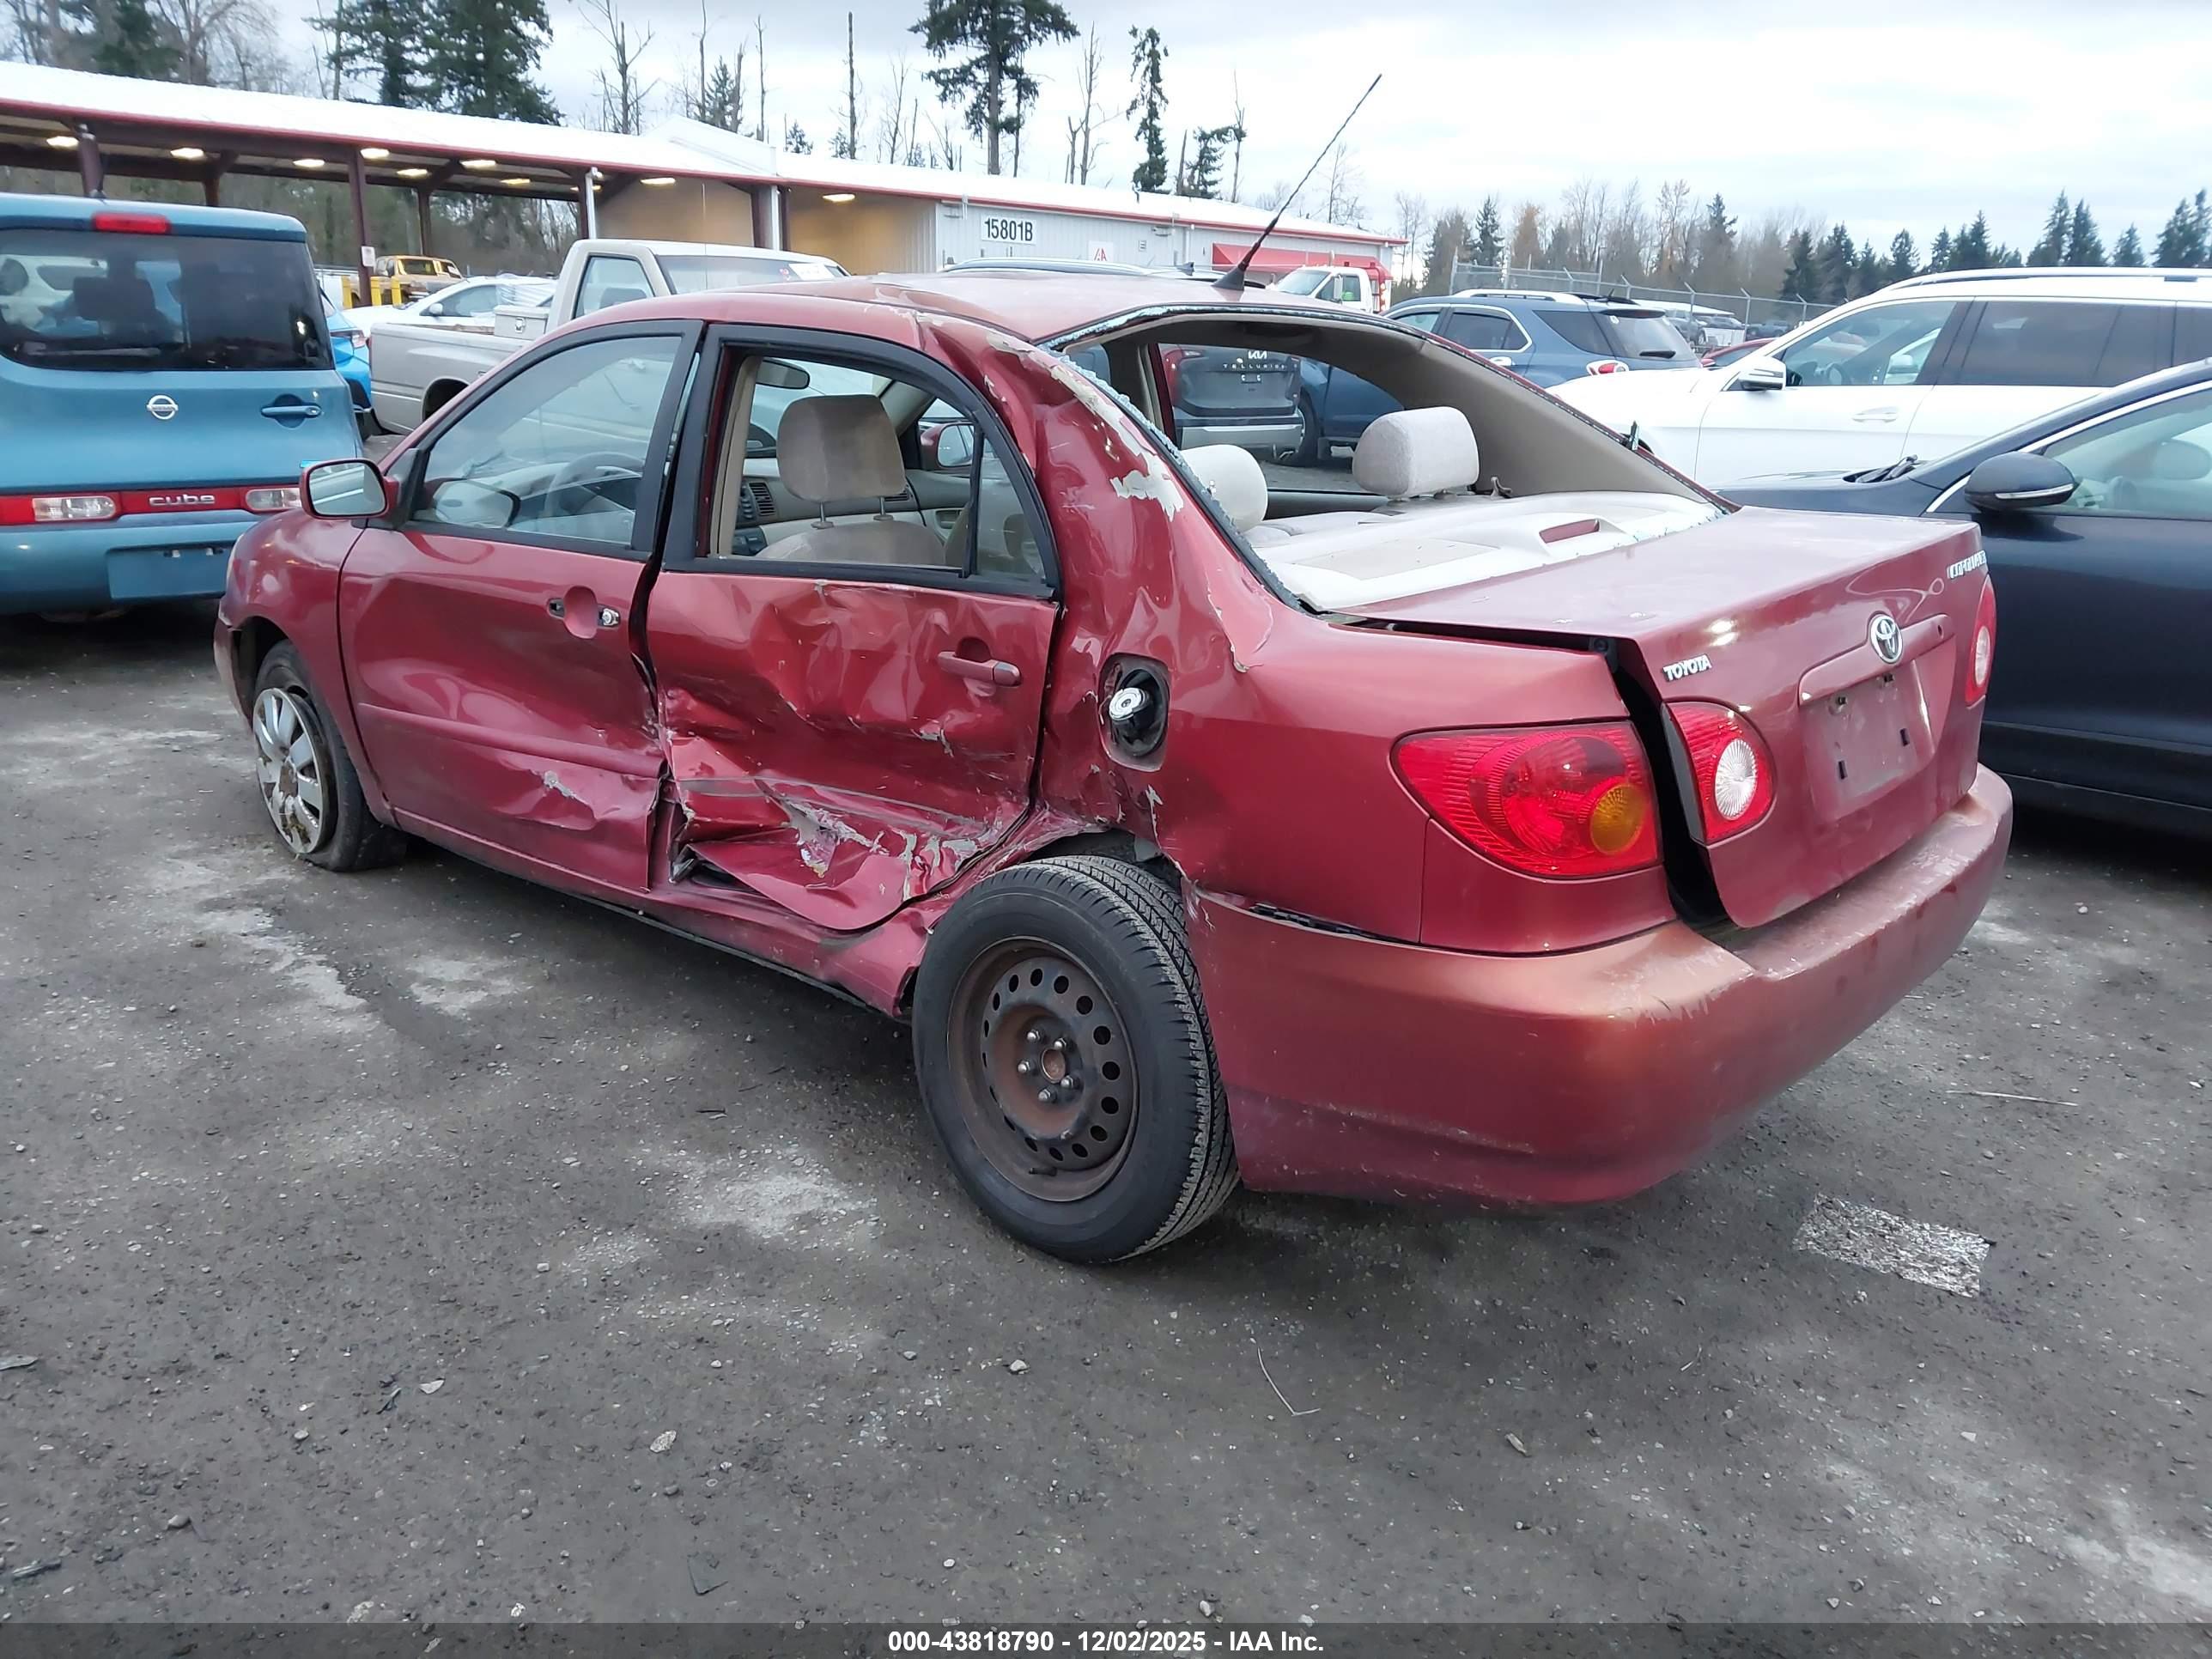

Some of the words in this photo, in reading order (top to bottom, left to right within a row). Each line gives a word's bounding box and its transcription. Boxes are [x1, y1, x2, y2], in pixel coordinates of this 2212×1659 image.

[984, 217, 1033, 241] 15801B
[149, 494, 216, 507] cube
[1662, 653, 1712, 681] TOYOTA
